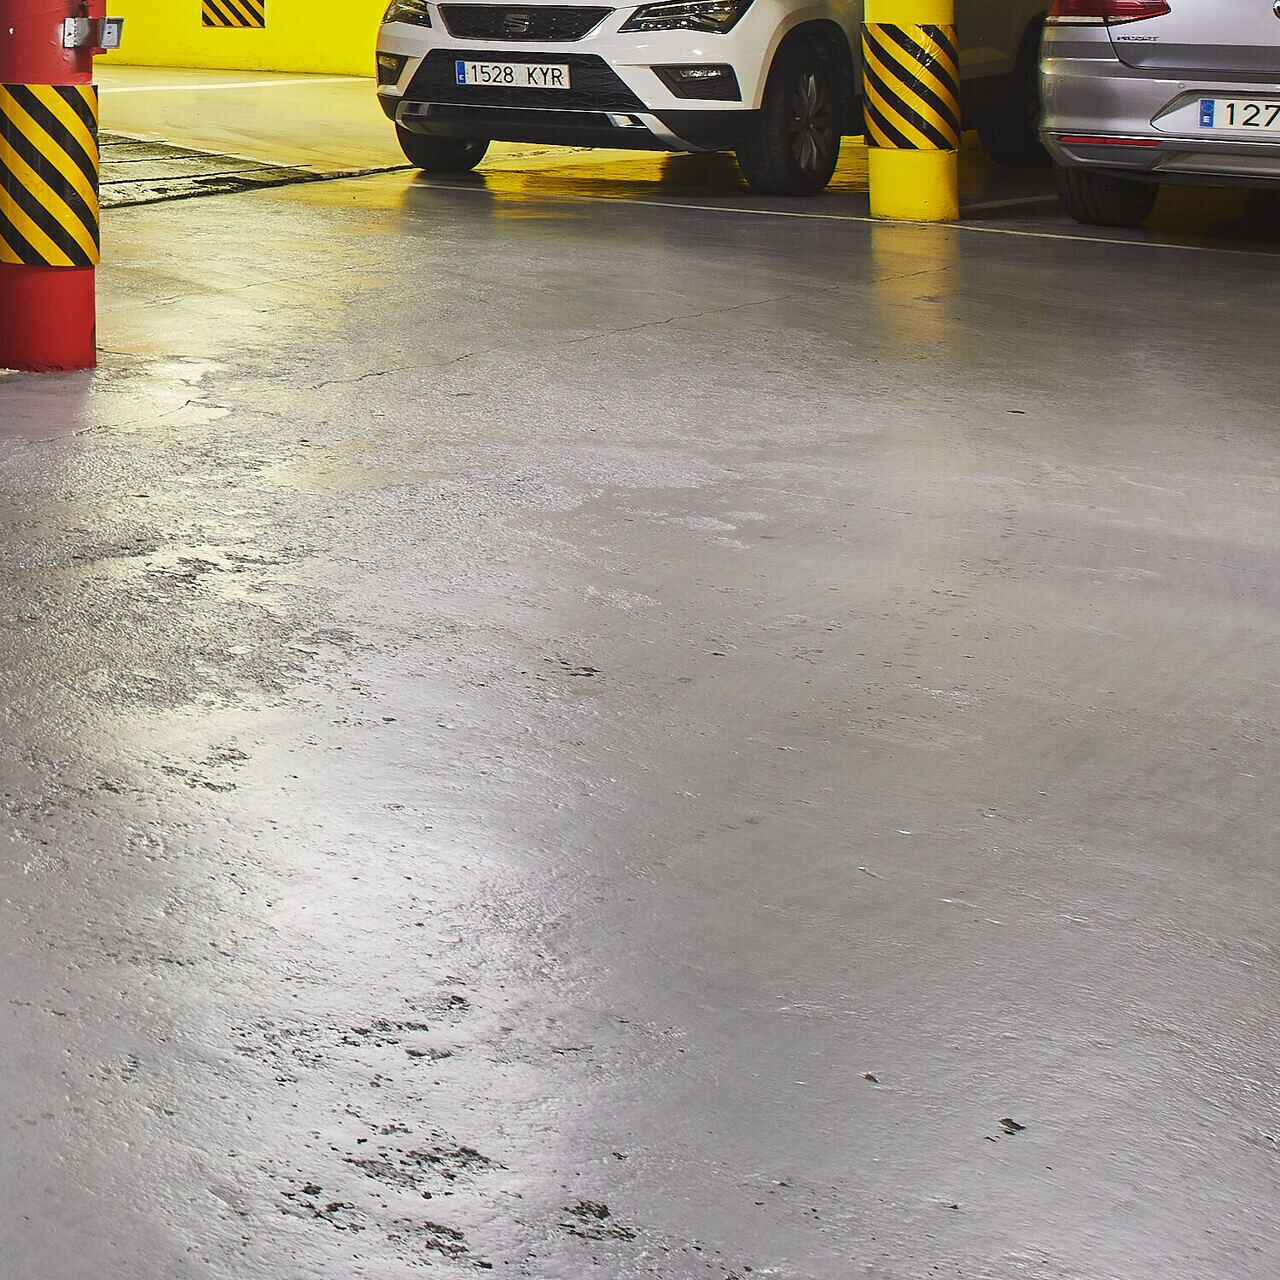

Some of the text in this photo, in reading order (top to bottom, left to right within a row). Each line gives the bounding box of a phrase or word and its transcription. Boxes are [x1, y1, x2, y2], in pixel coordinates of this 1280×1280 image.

[471, 64, 563, 85] 1528 KYR
[1226, 103, 1280, 127] 127
